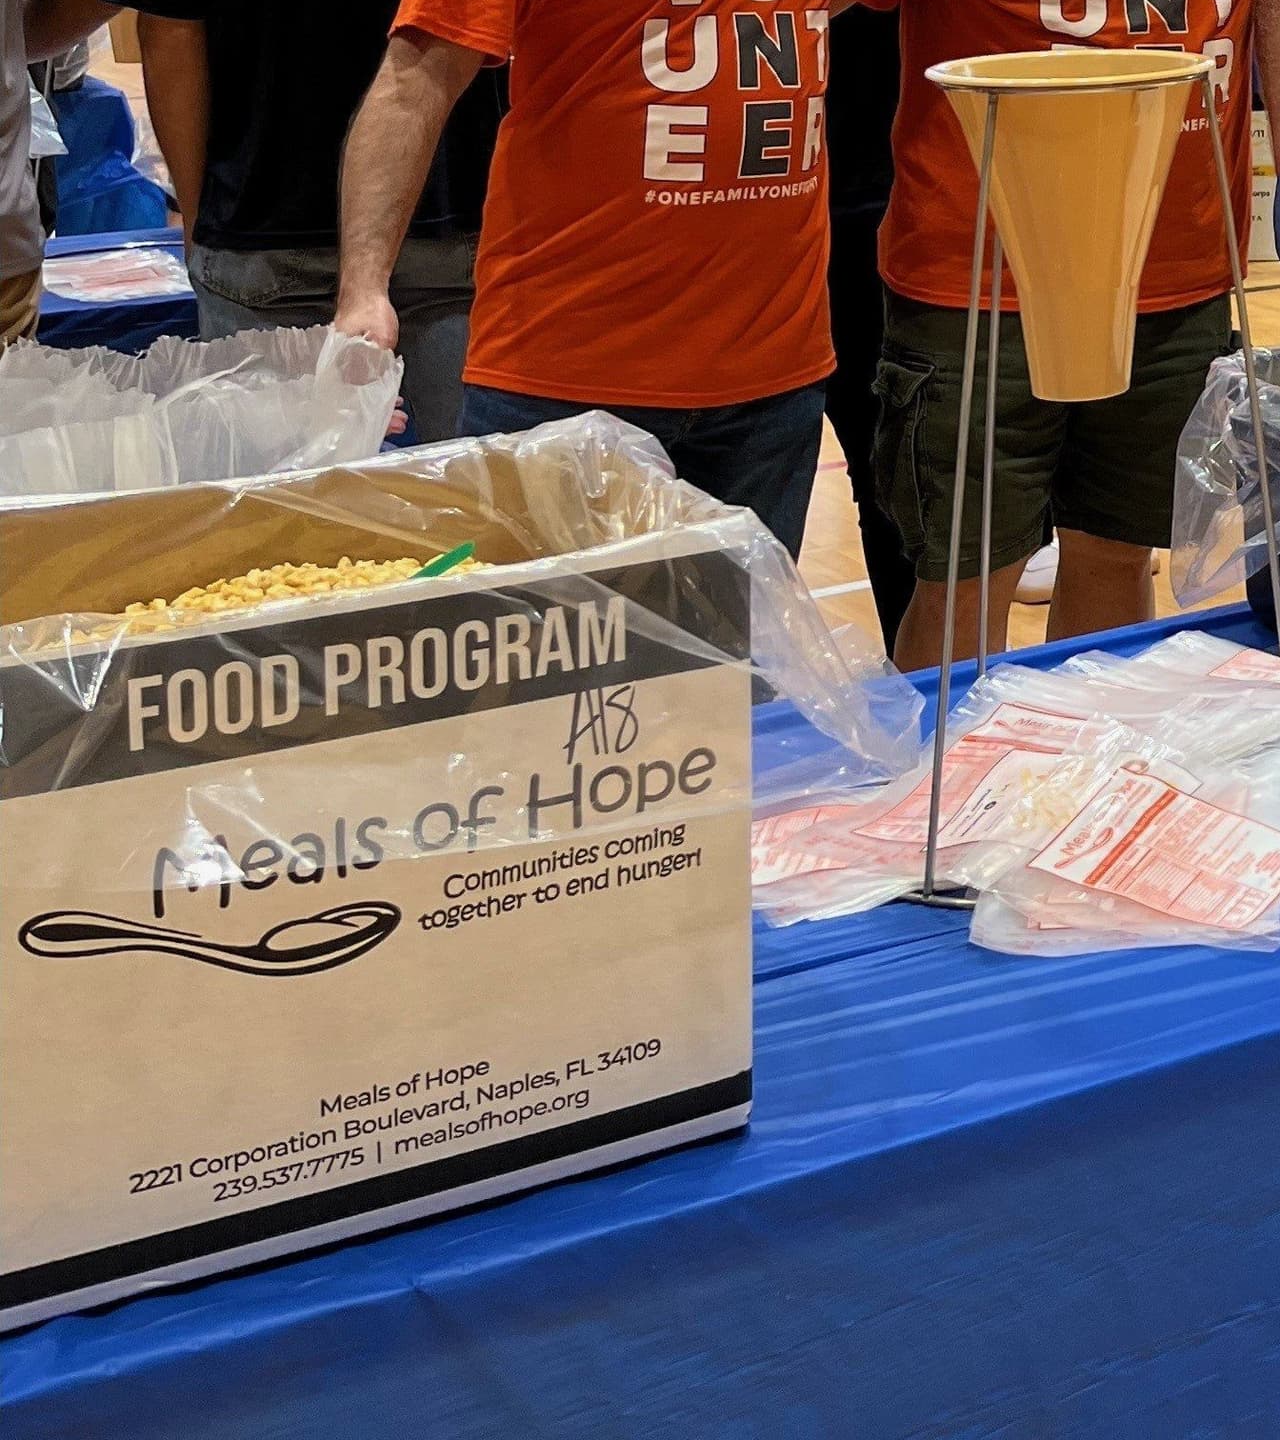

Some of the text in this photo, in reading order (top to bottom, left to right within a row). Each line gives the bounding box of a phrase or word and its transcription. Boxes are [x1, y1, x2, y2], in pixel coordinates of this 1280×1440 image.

[641, 10, 830, 92] UNT
[127, 594, 628, 753] FOOD PROGRAM
[153, 746, 717, 918] Meals of Hope
[442, 823, 688, 900] Communities coming
[417, 848, 702, 931] together to end hunger!
[129, 1038, 662, 1196] 2221 Corporation Boulevard, Naples, FL 34109
[319, 1059, 491, 1118] Meals of Hope
[213, 1148, 365, 1203] 239.537.7775
[394, 1087, 591, 1157] mealsofhope.org
